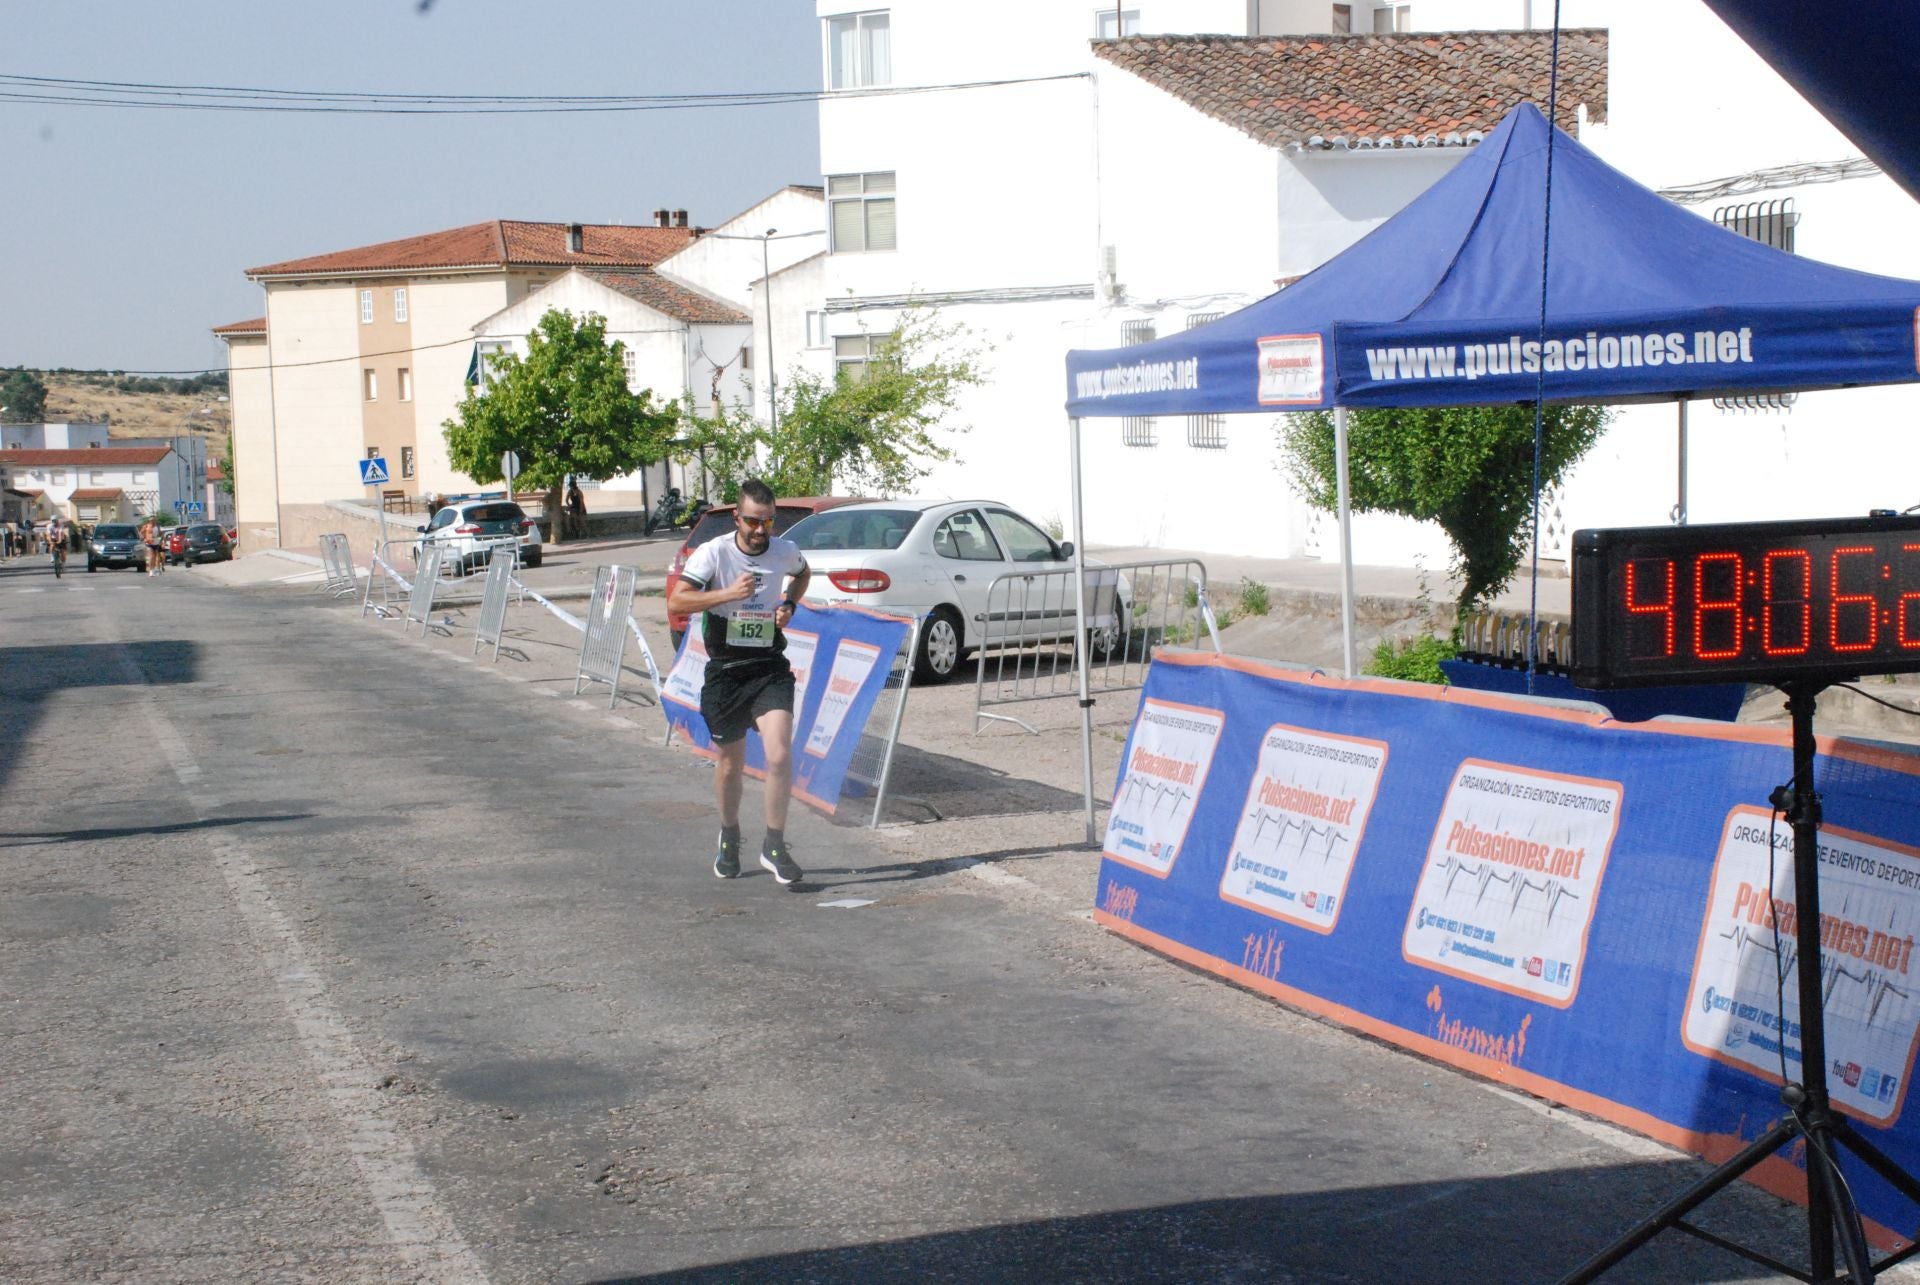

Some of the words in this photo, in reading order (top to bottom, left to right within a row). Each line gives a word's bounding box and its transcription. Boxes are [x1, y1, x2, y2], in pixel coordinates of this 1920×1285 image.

[1366, 327, 1753, 381] www.pulsaciones.net
[1076, 356, 1198, 399] www.pulsaciones.net
[739, 623, 763, 639] 152
[1338, 750, 1380, 769] DEPORTIVOS
[1257, 776, 1357, 826] Pulsaciones.net
[1511, 784, 1525, 798] DE
[1523, 786, 1560, 805] EVENTOS
[1558, 793, 1612, 815] DEPORTIVOS
[1446, 819, 1585, 881] Pulsaciones.net
[1829, 849, 1876, 876] EVENTOS
[1876, 862, 1920, 890] DEPORT
